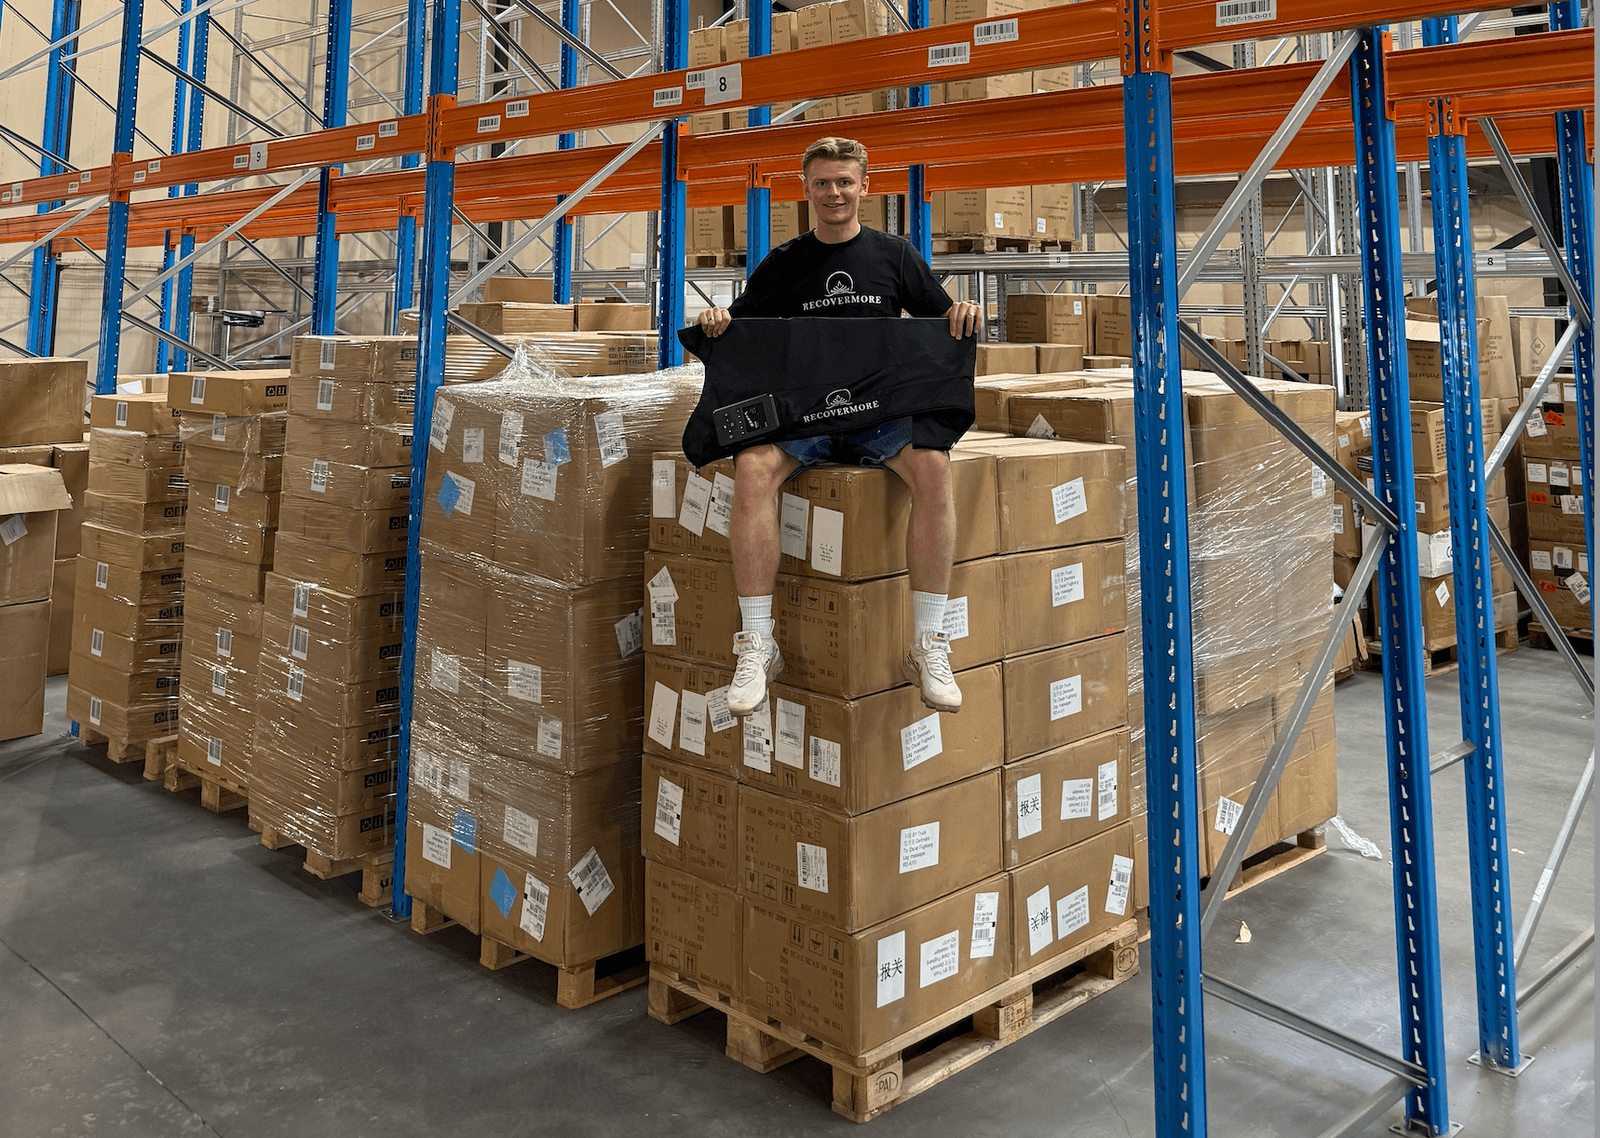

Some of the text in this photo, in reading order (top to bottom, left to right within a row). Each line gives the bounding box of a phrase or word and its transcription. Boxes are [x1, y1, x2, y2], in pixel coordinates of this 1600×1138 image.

[719, 76, 727, 92] 8
[256, 151, 261, 162] 9
[1486, 257, 1494, 266] 8
[802, 295, 882, 310] RECOVERMORE
[803, 400, 880, 424] RECOVERMORE
[1020, 798, 1040, 817] 报关
[880, 958, 903, 982] 报关
